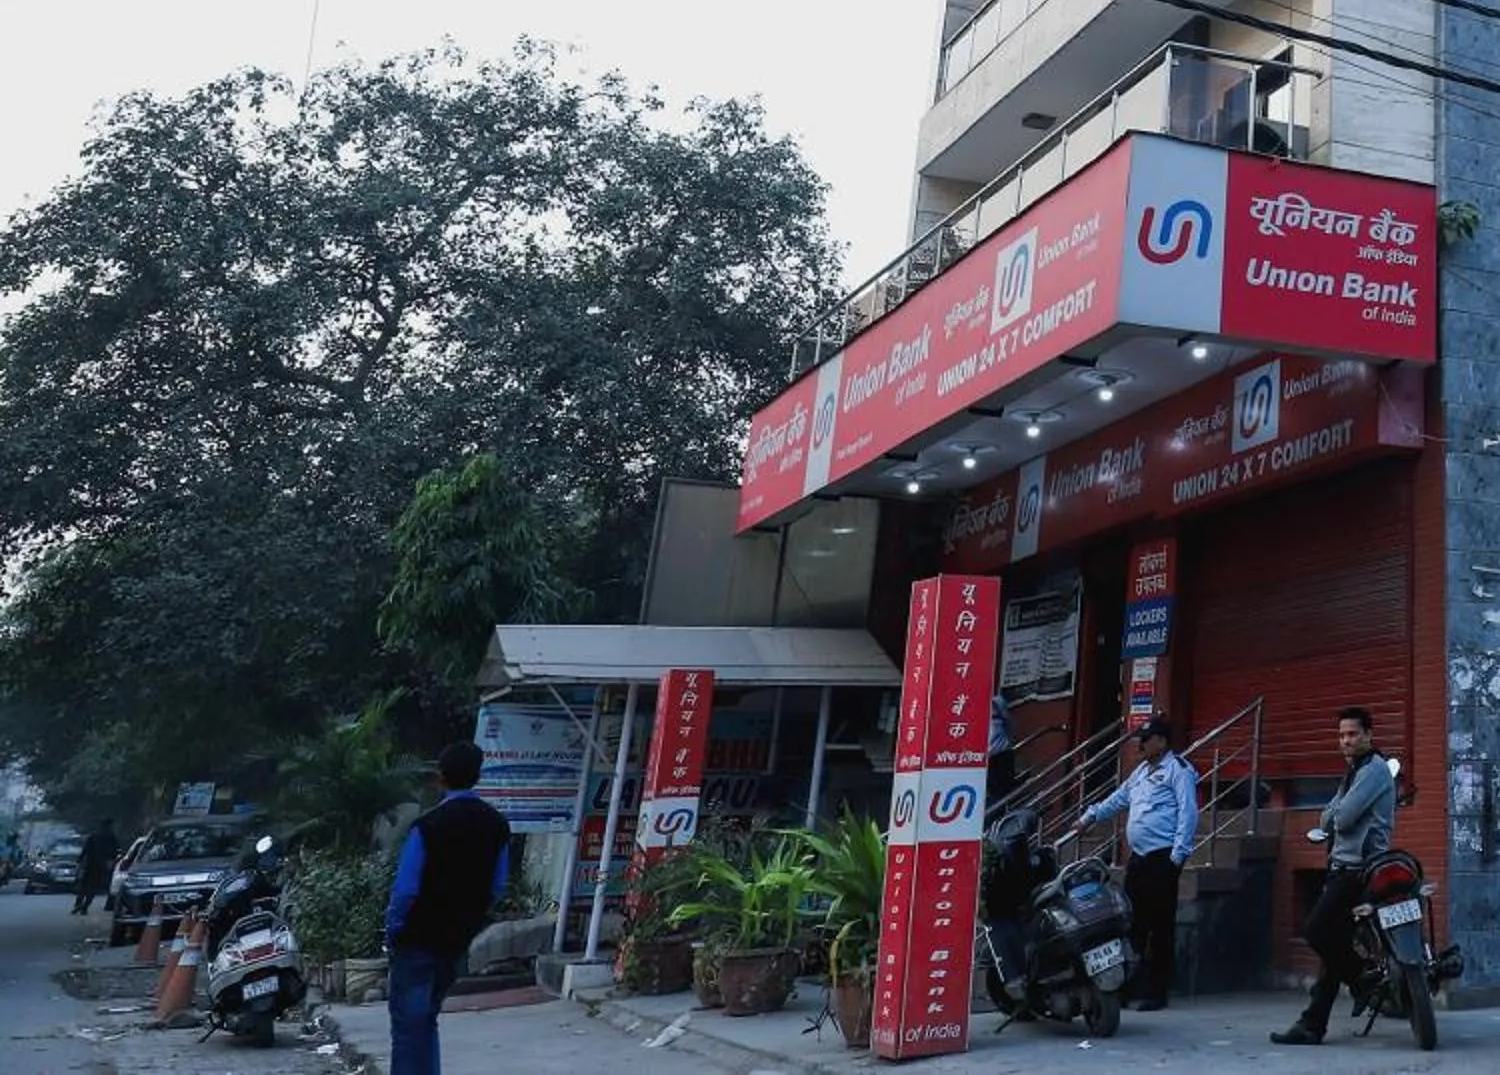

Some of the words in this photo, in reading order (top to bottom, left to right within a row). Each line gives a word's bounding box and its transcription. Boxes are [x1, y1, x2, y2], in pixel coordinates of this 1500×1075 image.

[1250, 192, 1364, 236] यूनियन
[1369, 208, 1418, 245] बैंक
[1246, 258, 1335, 295] Union
[1342, 273, 1418, 307] Bank
[1362, 307, 1379, 320] of
[844, 360, 886, 413] Union
[888, 323, 932, 385] Bank
[937, 353, 977, 397] UNION
[977, 342, 995, 372] 24
[998, 333, 1009, 362] X
[1011, 327, 1020, 354] 7
[1023, 280, 1097, 346] COMFORT
[1049, 462, 1095, 506] Union
[1098, 435, 1146, 482] Bank
[1173, 469, 1217, 504] UNION
[1219, 462, 1239, 489] 24
[1242, 457, 1255, 481] X
[1257, 452, 1267, 475] 7
[1271, 419, 1355, 471] COMFORT
[1125, 626, 1168, 649] AVAILABLE
[934, 848, 959, 927] Union
[928, 950, 949, 1014] Bank
